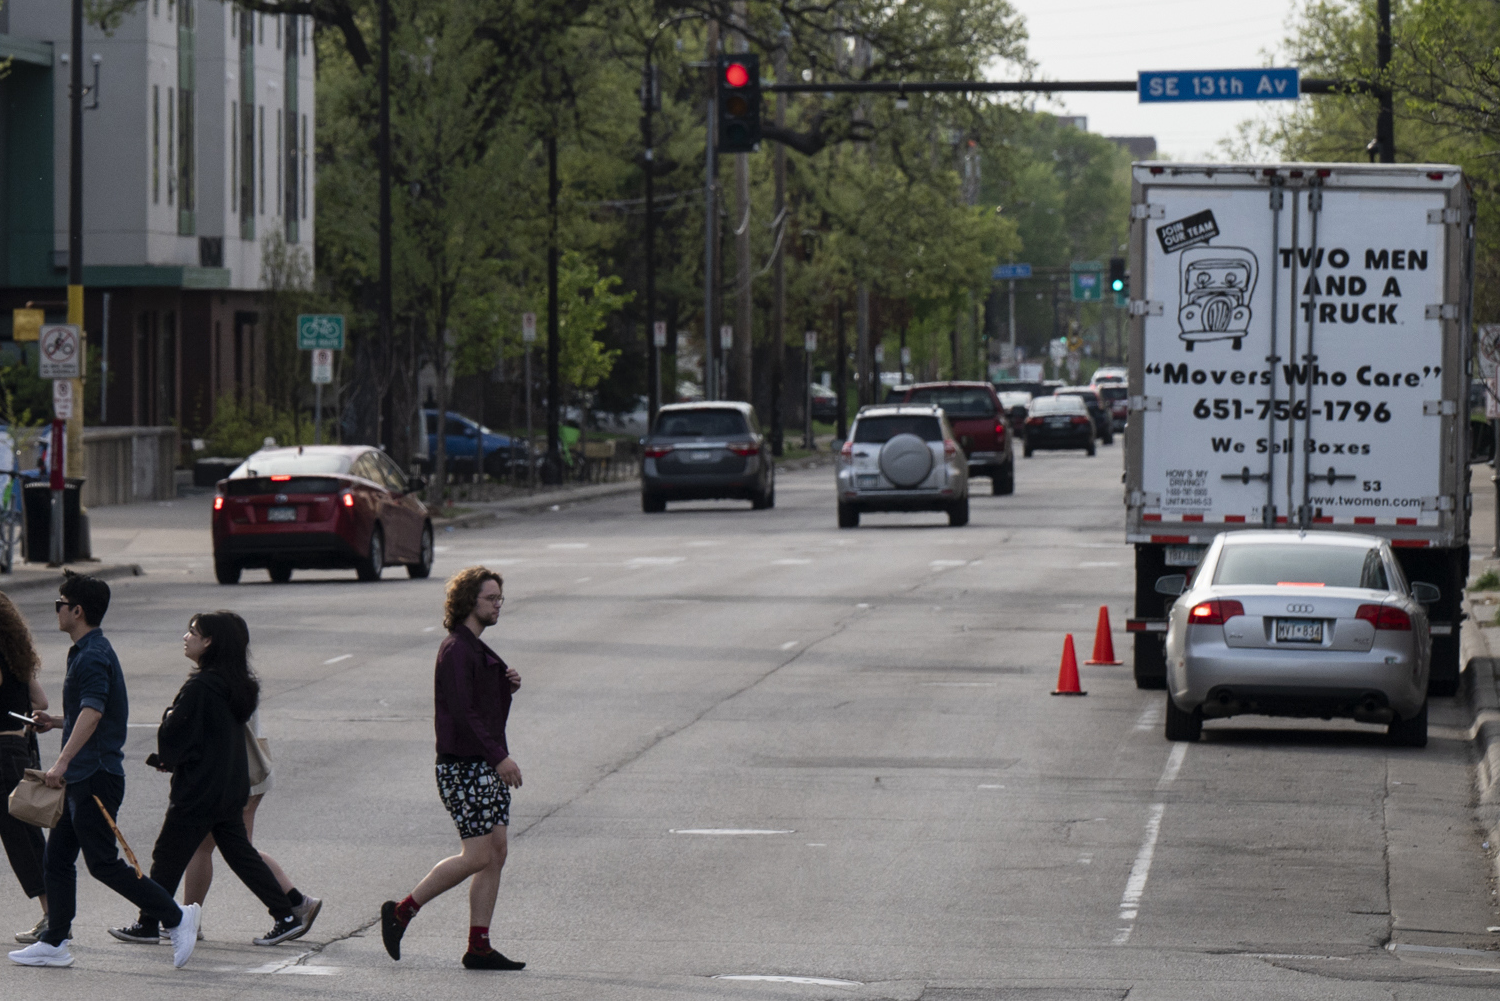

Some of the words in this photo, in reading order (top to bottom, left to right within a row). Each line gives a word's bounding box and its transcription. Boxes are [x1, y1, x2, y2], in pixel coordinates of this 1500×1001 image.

[1149, 77, 1180, 97] SE
[1192, 76, 1244, 95] 13th
[1256, 74, 1290, 94] Av
[1161, 221, 1185, 238] JOIN
[1164, 232, 1187, 247] OUR
[1187, 221, 1214, 238] TEAM
[1279, 247, 1351, 269] TWO
[1366, 248, 1429, 271] MEN
[1304, 274, 1368, 297] AND
[1383, 276, 1404, 297] A
[1301, 302, 1399, 325] TRUCK
[1282, 363, 1348, 387] Who
[1193, 398, 1392, 424] 651-756-1796
[1211, 437, 1246, 453] We
[1256, 438, 1294, 455] Sell
[1305, 439, 1372, 455] Boxes
[1165, 469, 1193, 478] HOW'S
[1195, 469, 1208, 478] MY
[1363, 480, 1382, 492] 53
[1306, 495, 1422, 508] www.twomen.com
[1302, 624, 1320, 638] 834
